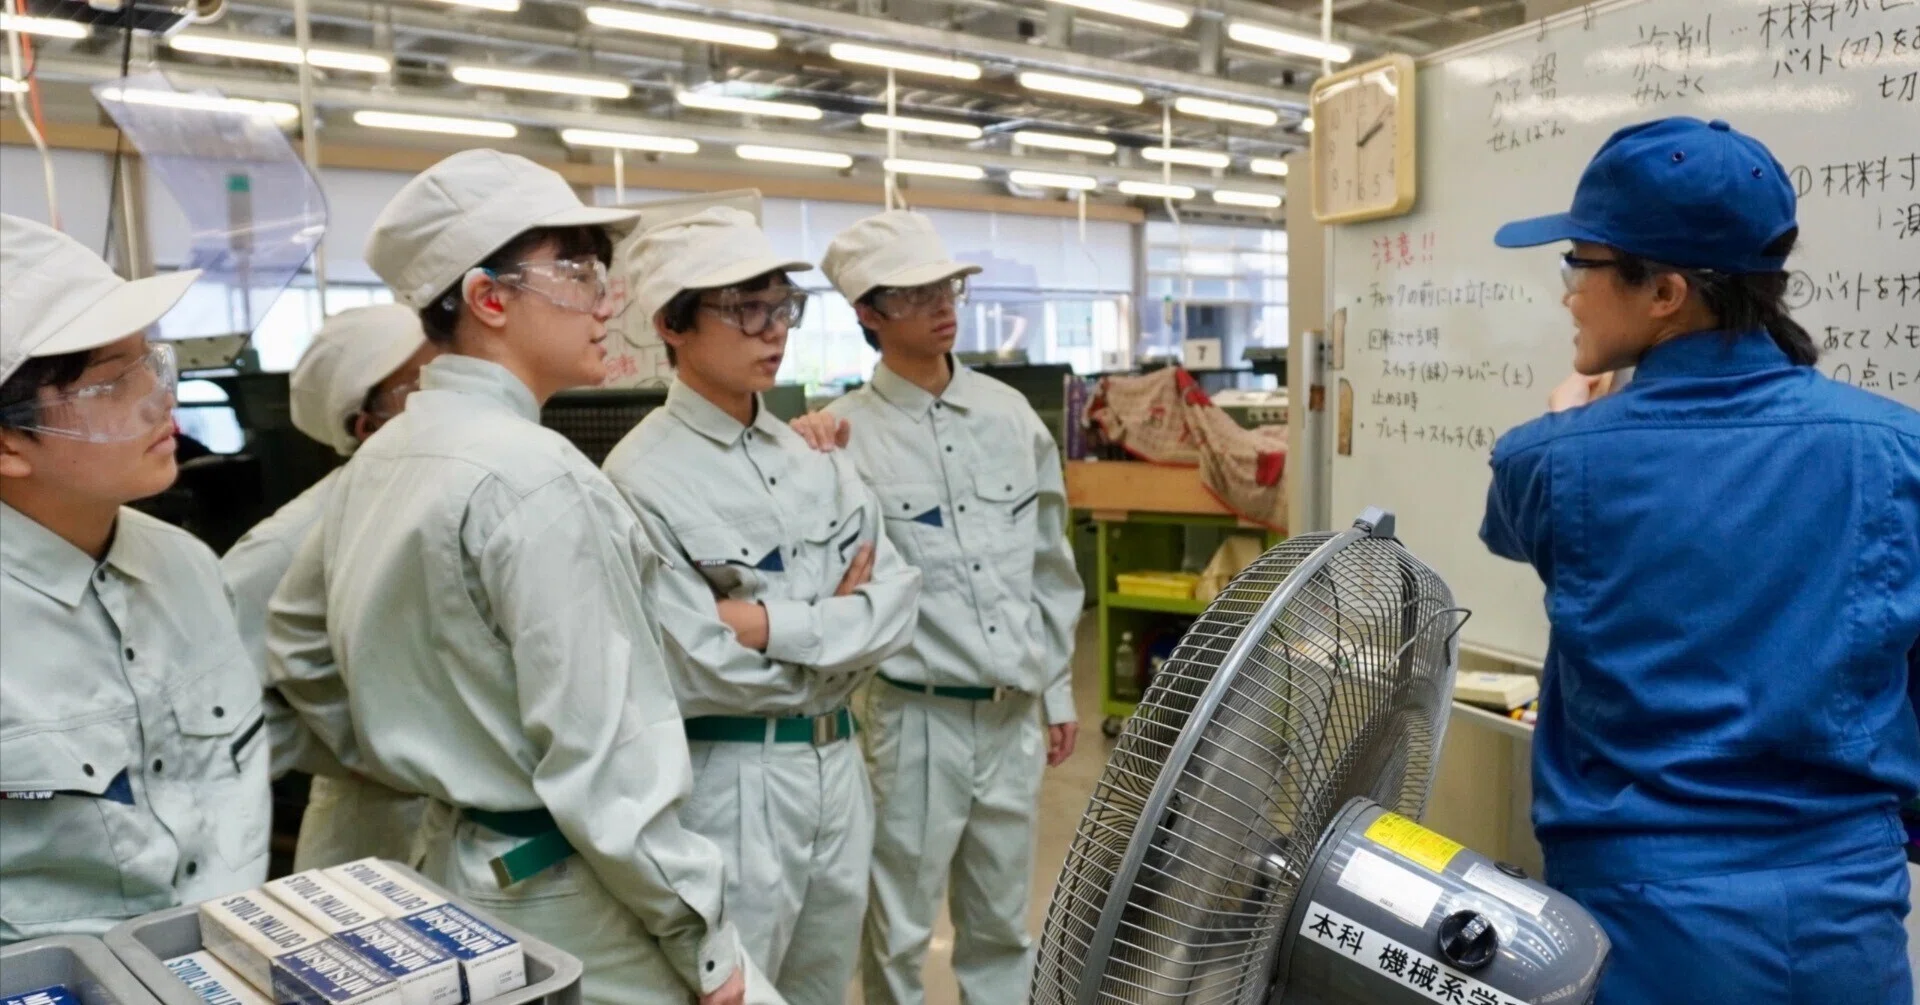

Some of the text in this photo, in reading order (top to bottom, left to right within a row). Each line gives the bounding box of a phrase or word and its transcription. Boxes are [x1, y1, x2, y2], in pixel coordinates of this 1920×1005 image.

[1486, 119, 1566, 152] せんばん
[282, 875, 366, 926] CUTTING TOOLS
[343, 863, 428, 911] CUTTING TOOLS
[221, 895, 308, 949] CUTTING TOOLS
[1308, 912, 1363, 955] 本科
[167, 957, 212, 987] TOOLS
